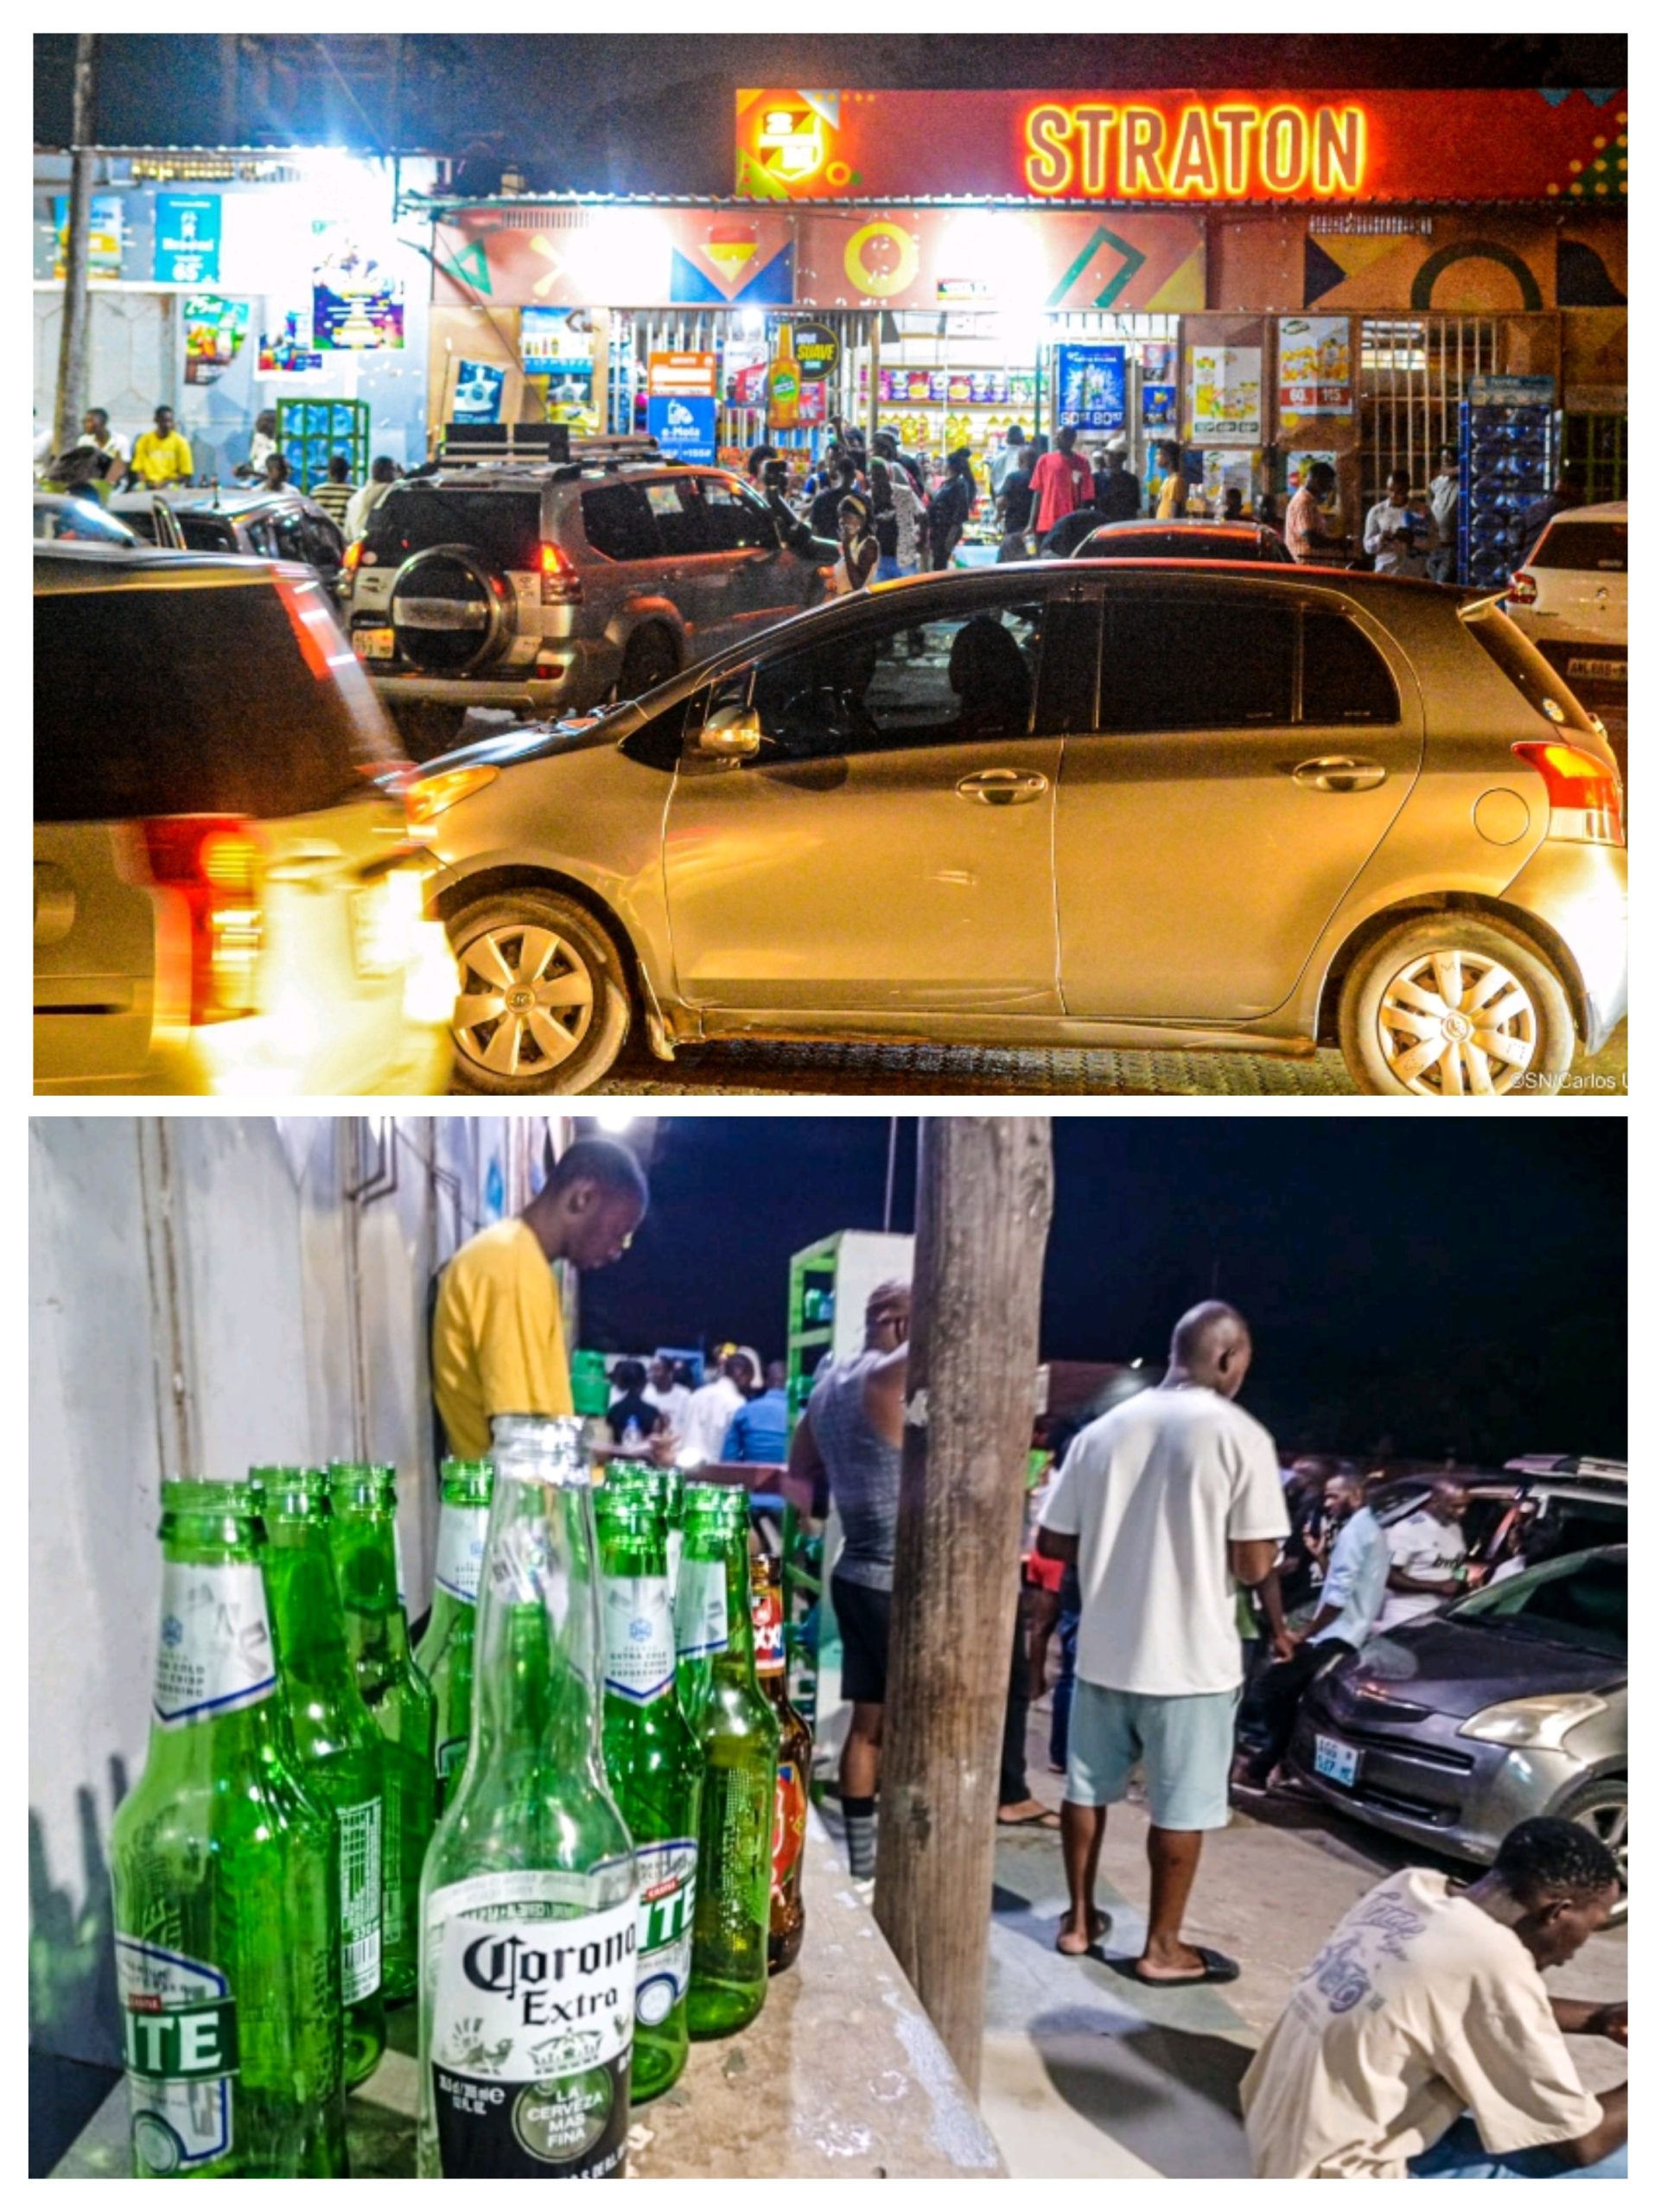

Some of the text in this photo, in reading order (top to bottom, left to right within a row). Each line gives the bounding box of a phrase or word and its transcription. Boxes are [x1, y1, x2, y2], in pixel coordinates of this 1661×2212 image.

[1027, 105, 1363, 194] STRATON
[798, 344, 835, 360] SUAVE
[661, 426, 701, 438] e-Mola
[639, 1876, 696, 1950] ITE
[462, 1923, 637, 2001] Corona
[522, 1987, 618, 2027] Extra
[125, 2010, 223, 2073] ITE
[528, 2091, 603, 2122] CERVEZA
[556, 2085, 582, 2101] LA
[548, 2113, 586, 2134] MAS
[548, 2128, 587, 2149] FINA
